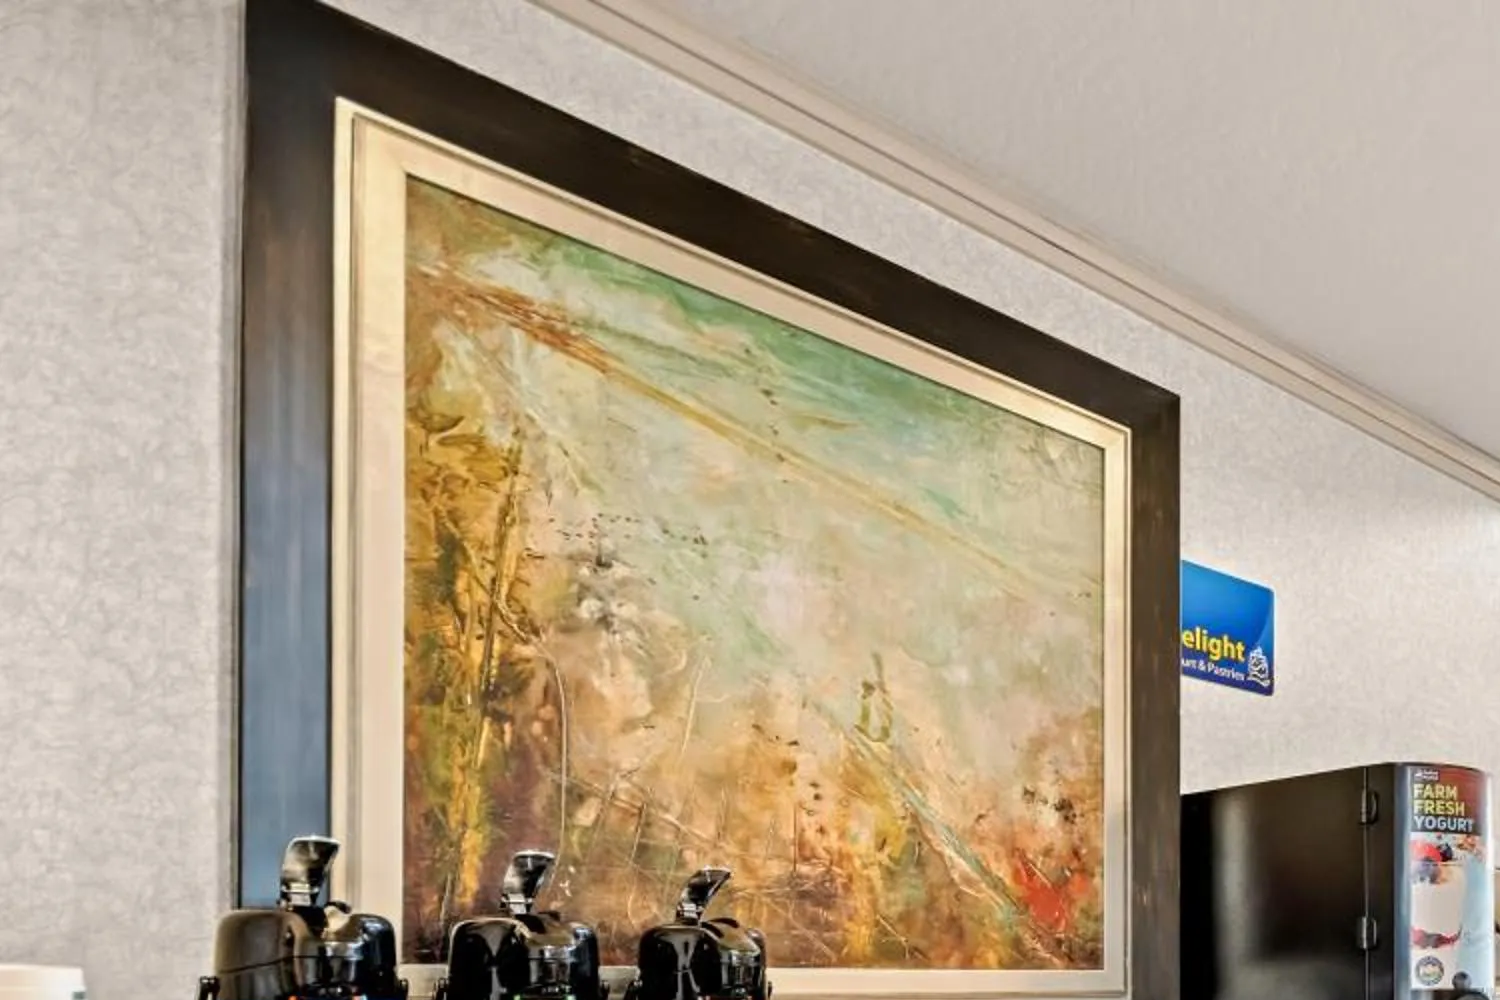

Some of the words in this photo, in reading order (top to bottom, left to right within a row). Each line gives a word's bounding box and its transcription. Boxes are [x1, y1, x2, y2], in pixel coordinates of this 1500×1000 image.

[1182, 626, 1245, 662] elight
[1413, 783, 1458, 800] FARM
[1413, 799, 1466, 816] FRESH
[1413, 815, 1474, 832] YOGURT
